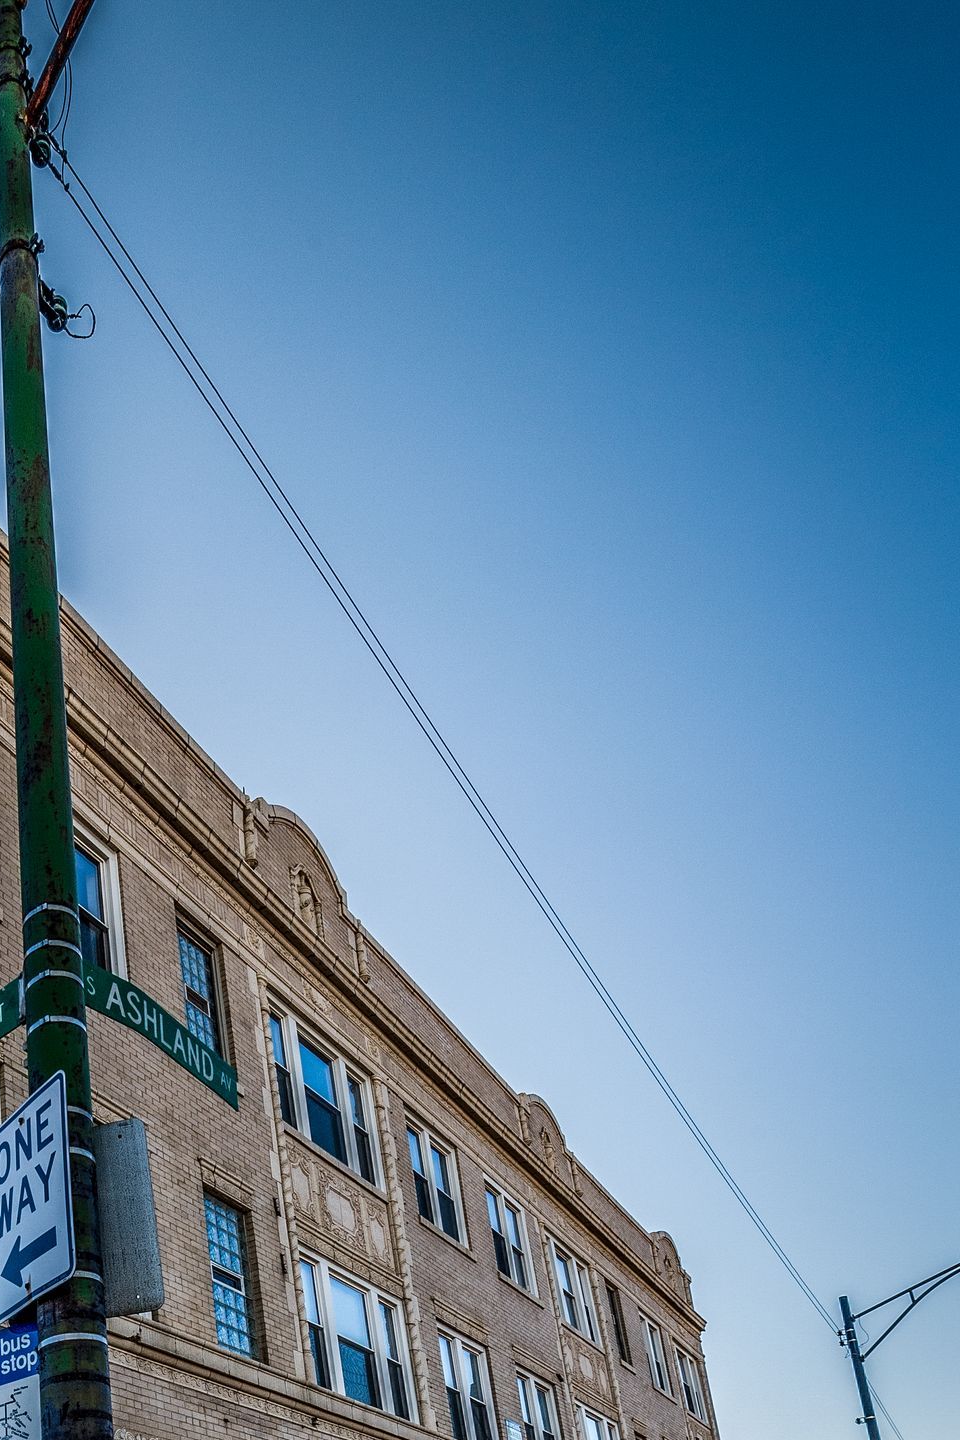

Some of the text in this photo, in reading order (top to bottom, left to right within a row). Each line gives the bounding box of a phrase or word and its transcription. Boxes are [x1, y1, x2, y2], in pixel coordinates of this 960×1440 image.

[86, 974, 233, 1093] S ASHLAND AV
[0, 1333, 31, 1356] bus
[0, 1350, 38, 1375] stop
